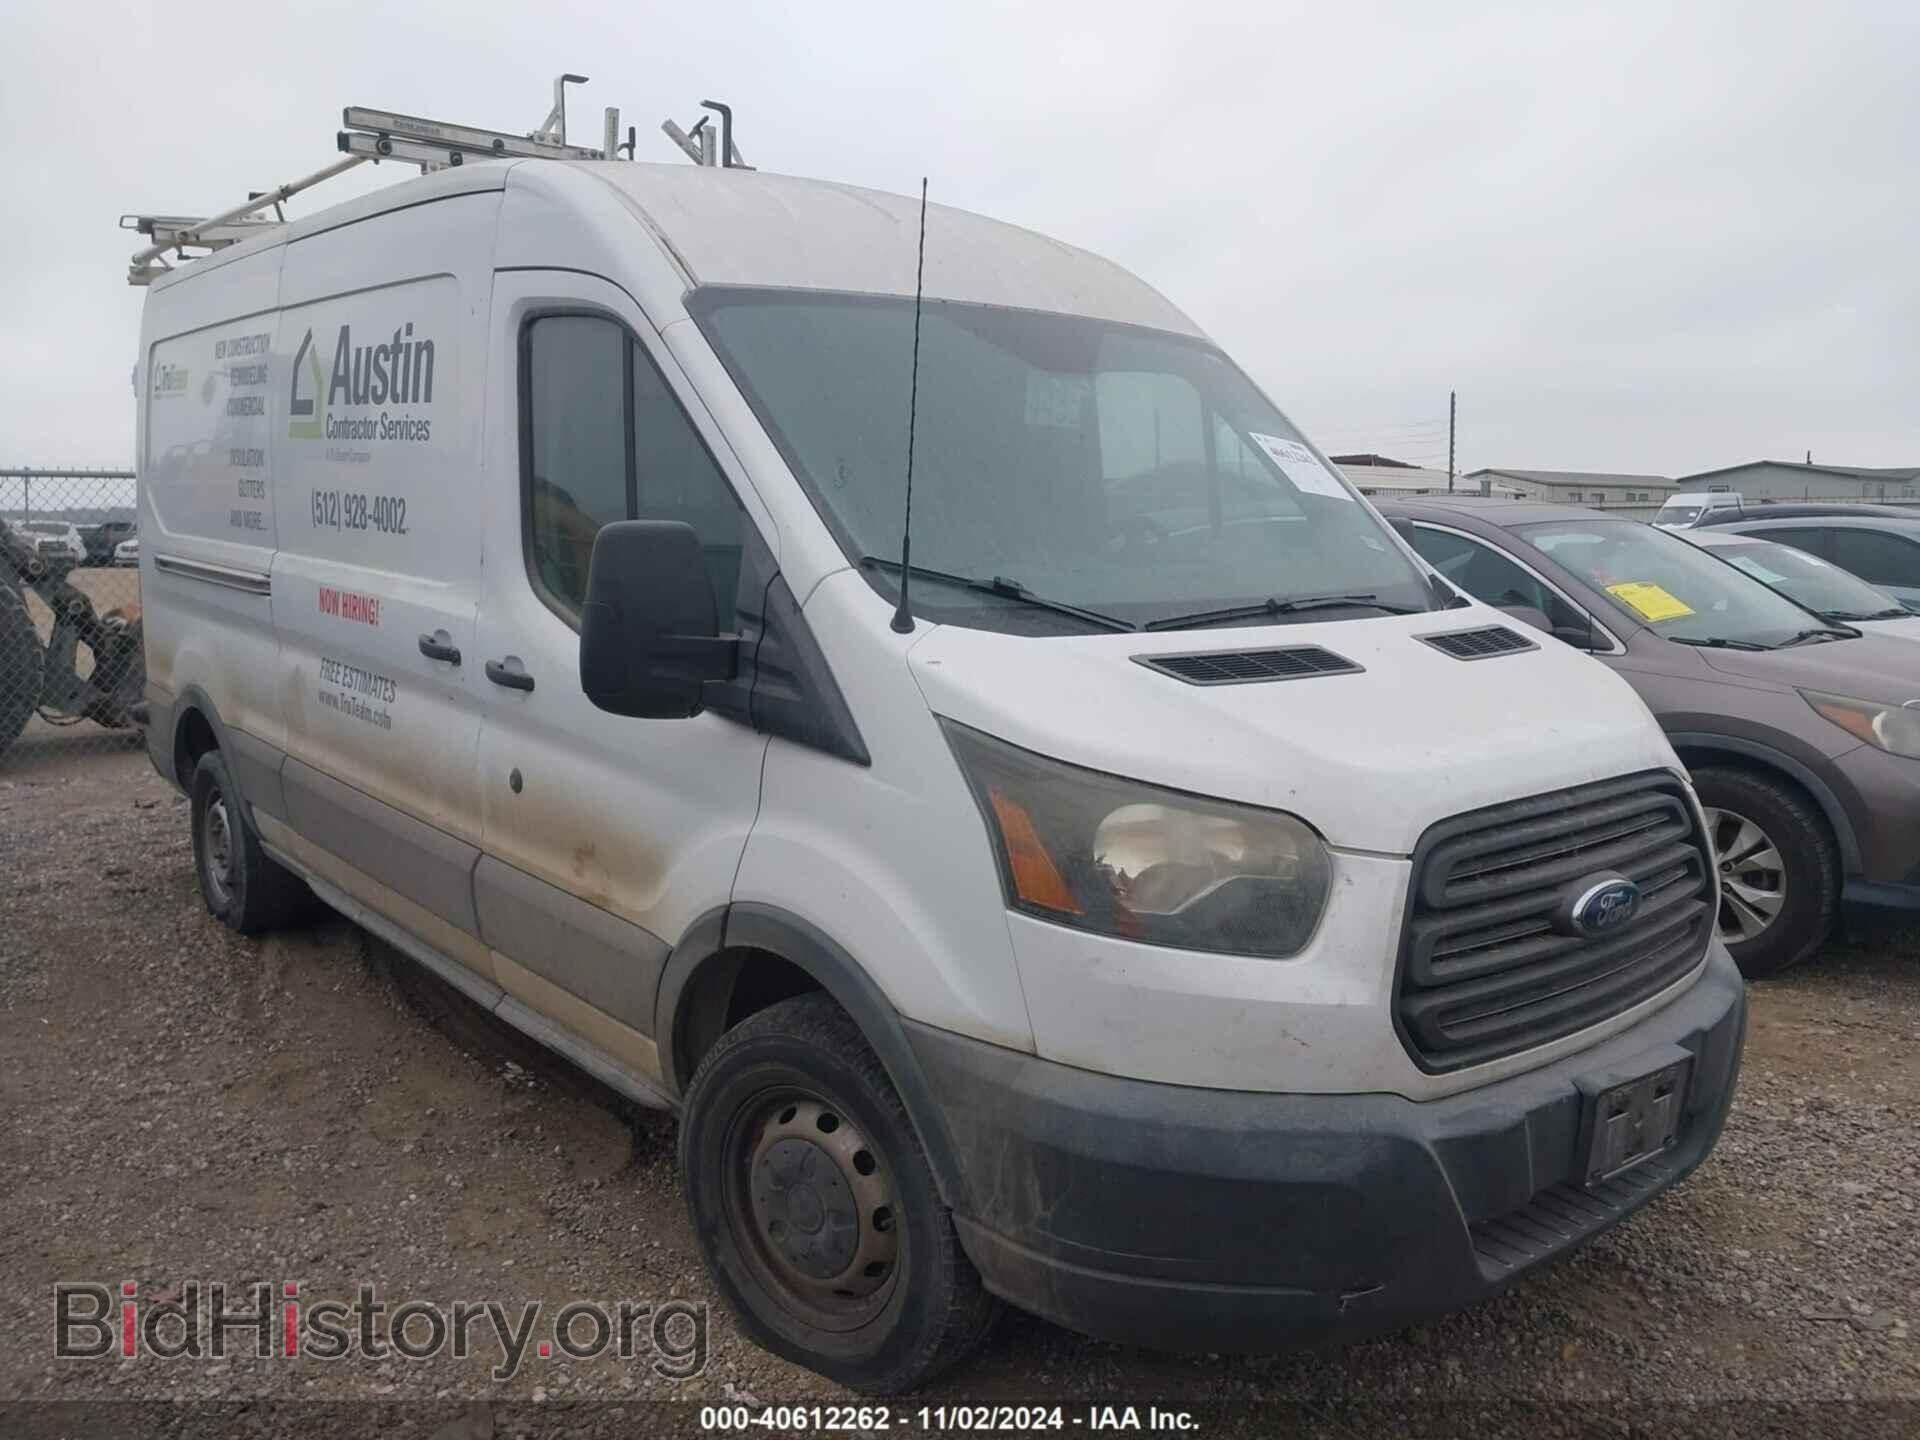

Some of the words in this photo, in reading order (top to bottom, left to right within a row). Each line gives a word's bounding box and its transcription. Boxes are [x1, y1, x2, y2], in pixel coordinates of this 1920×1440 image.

[327, 322, 435, 405] Austin
[326, 412, 378, 440] Contractor
[379, 411, 431, 441] Services
[238, 479, 265, 500] GUTTERS
[311, 488, 341, 532] (512)
[344, 493, 405, 534] 928-4002
[319, 587, 339, 616] NOW
[342, 591, 380, 626] HIRING!
[319, 657, 340, 684] FREE
[342, 663, 398, 704] ESTIMATES
[1597, 889, 1633, 927] Ford
